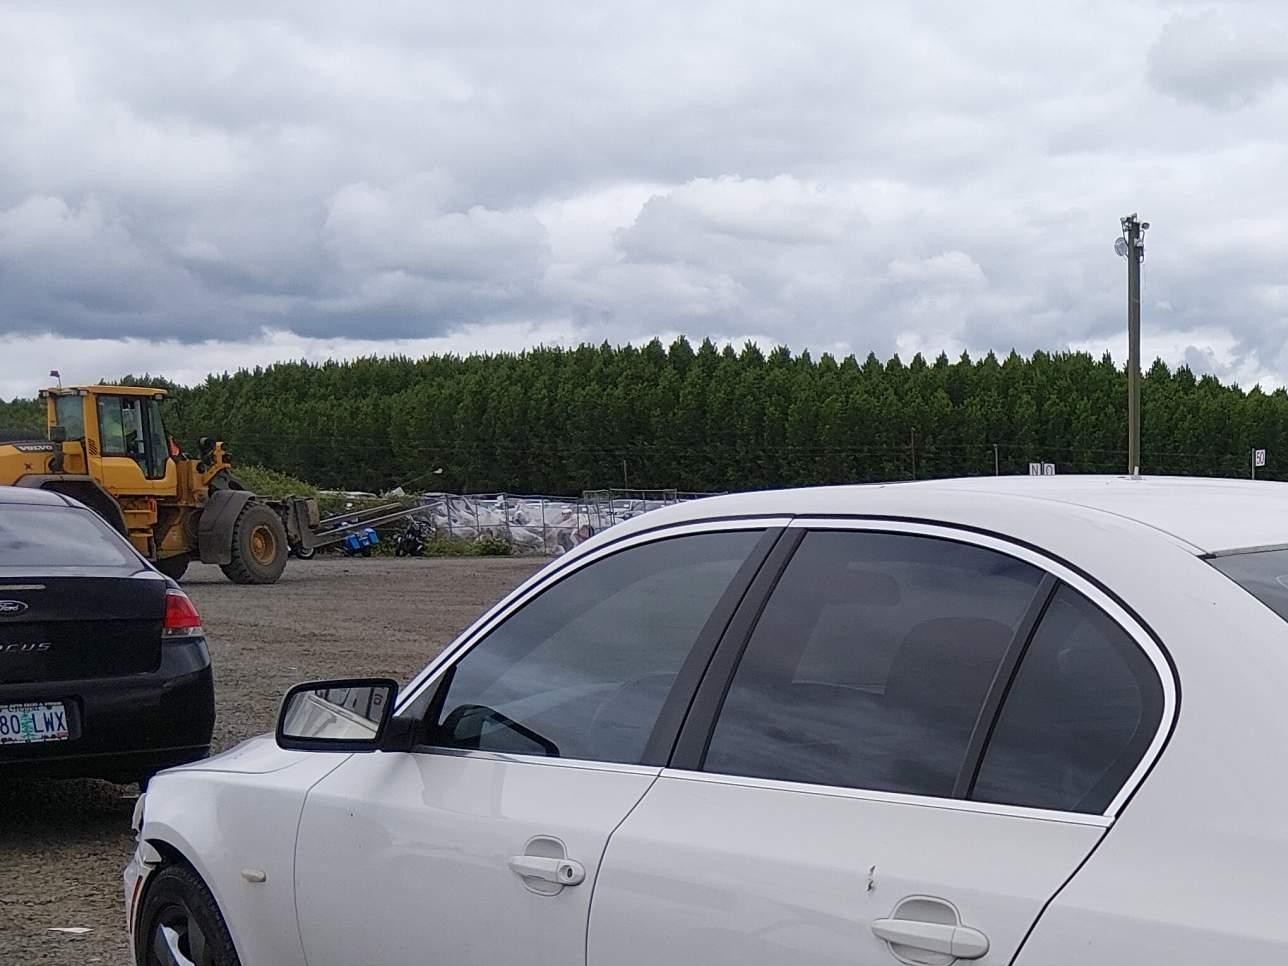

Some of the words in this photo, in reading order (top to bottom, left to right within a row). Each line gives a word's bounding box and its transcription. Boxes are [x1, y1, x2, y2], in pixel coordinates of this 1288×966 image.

[1257, 451, 1265, 465] 50
[1032, 465, 1039, 476] N
[0, 643, 51, 653] CUS
[31, 711, 66, 733] LWX
